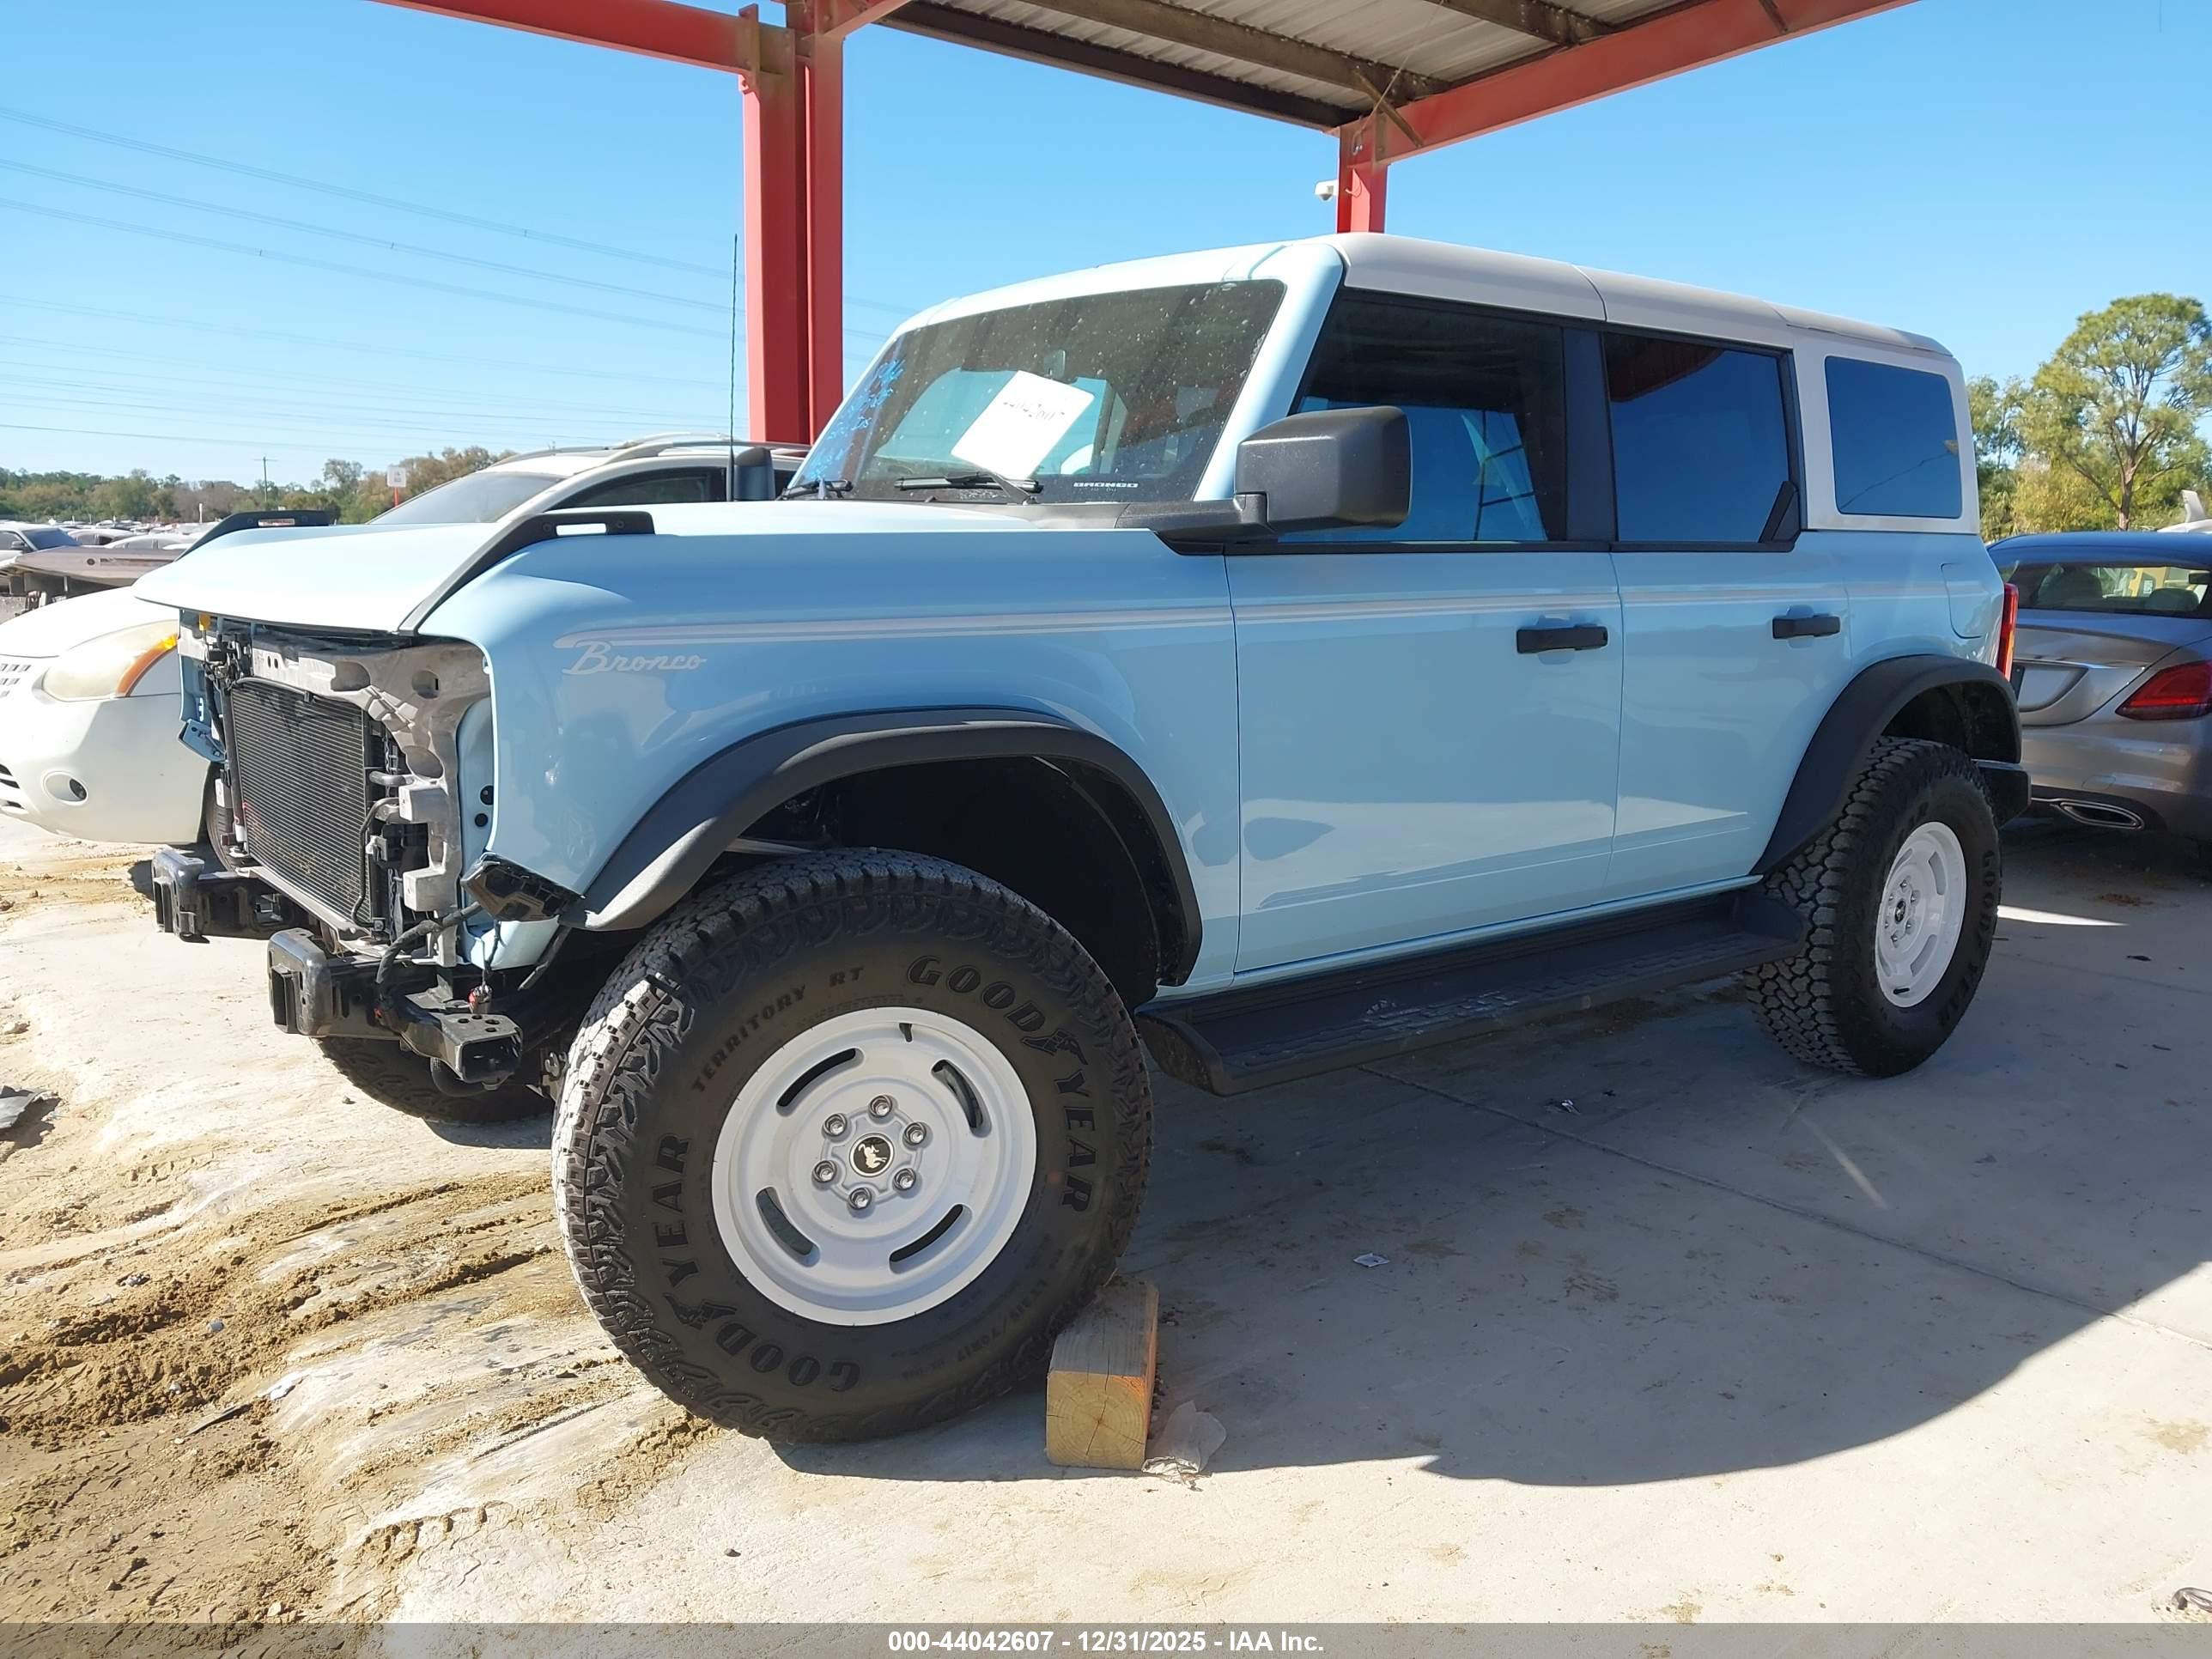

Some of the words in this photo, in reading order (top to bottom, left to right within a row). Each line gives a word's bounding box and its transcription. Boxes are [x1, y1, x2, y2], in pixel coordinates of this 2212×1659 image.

[562, 640, 708, 676] Bronco
[690, 983, 805, 1093] TERRITORY
[828, 965, 864, 988] RT
